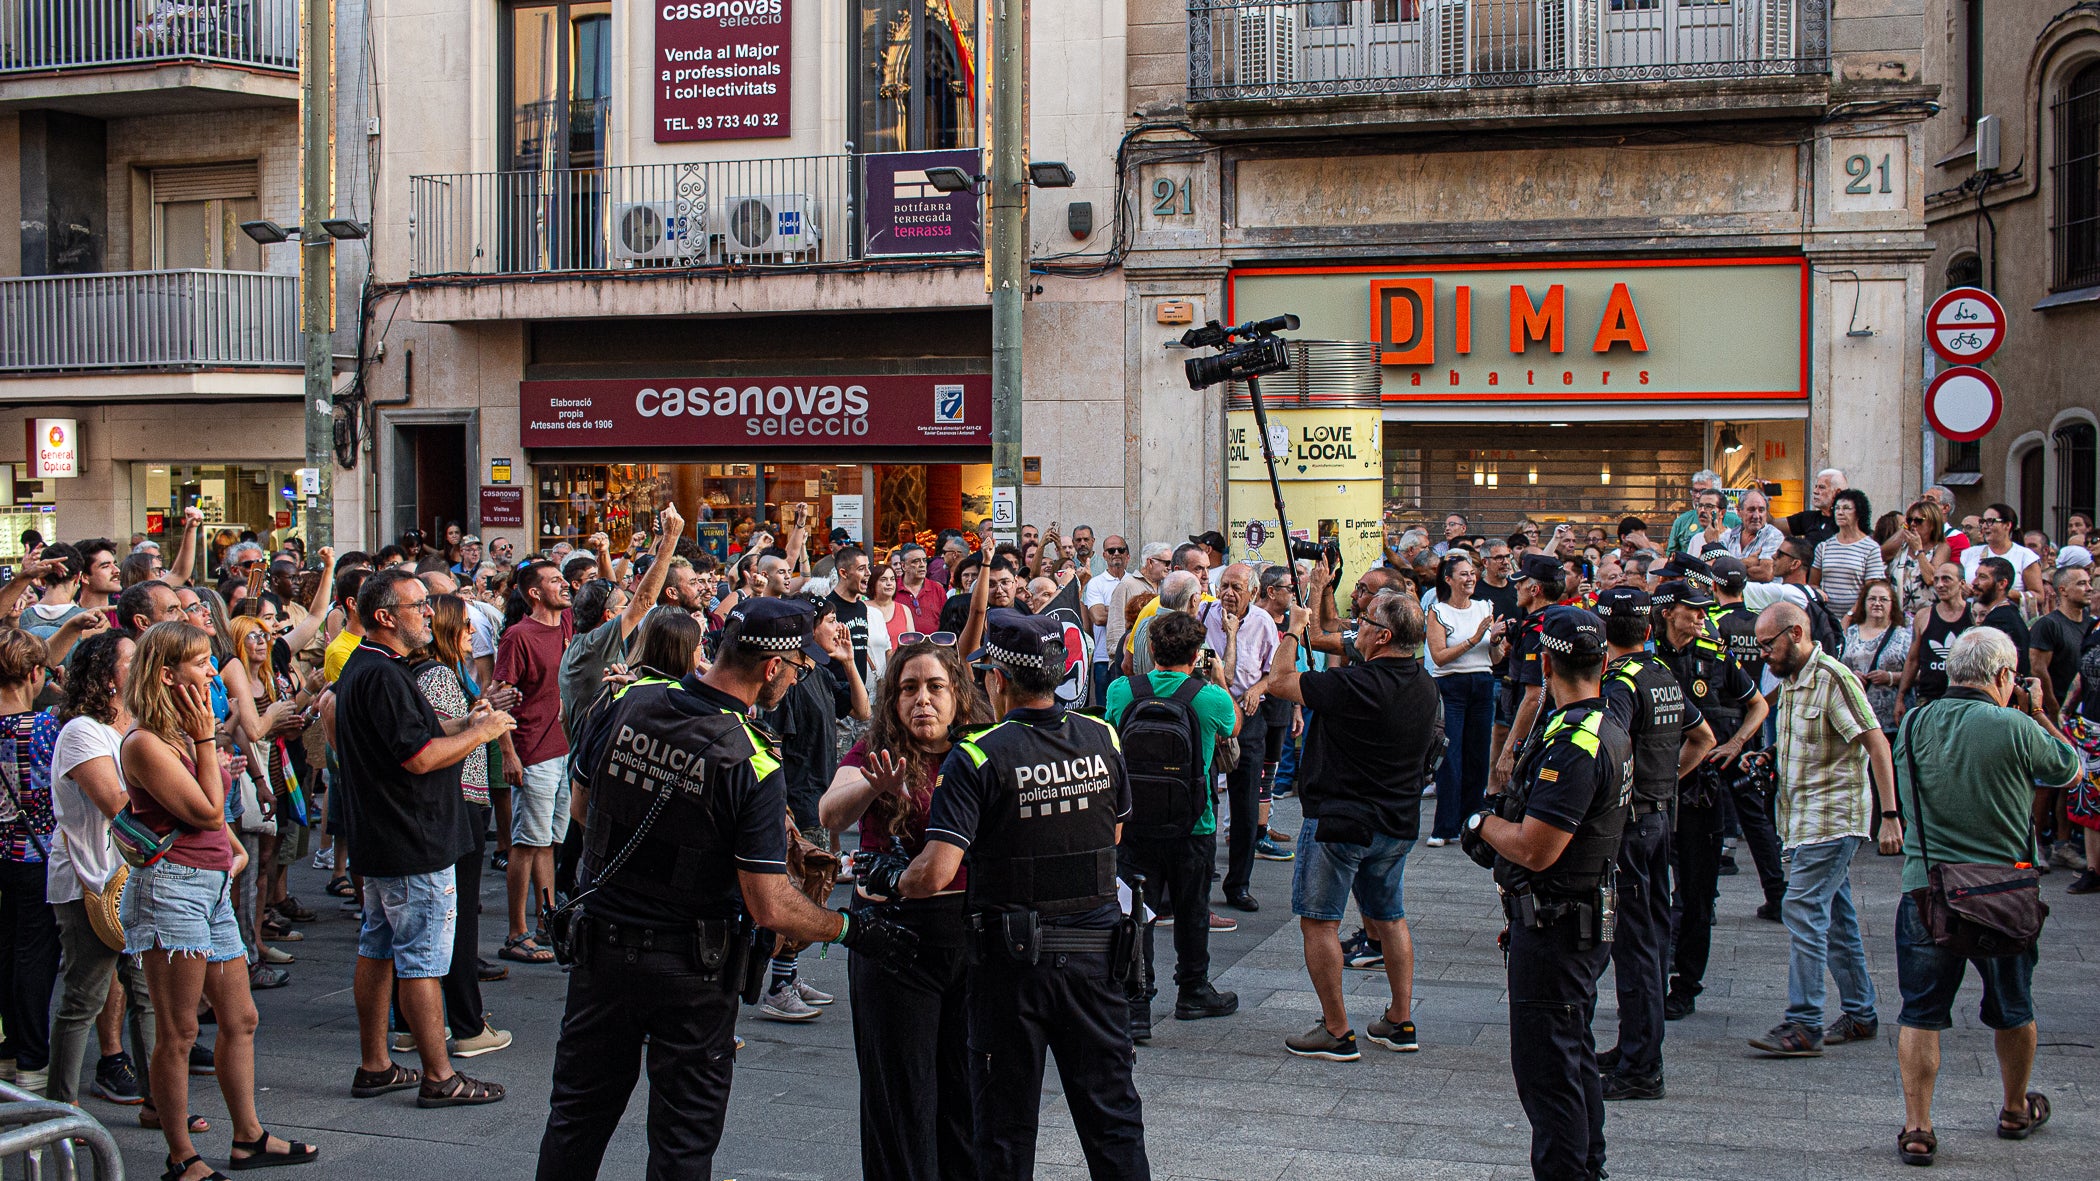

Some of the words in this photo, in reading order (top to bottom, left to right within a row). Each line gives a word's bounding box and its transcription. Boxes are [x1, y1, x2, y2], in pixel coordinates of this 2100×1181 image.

[663, 0, 782, 20] casanovas
[720, 11, 782, 28] selecció
[664, 46, 713, 62] Venda
[717, 45, 731, 59] al
[735, 43, 780, 60] Major
[662, 70, 671, 81] a
[675, 61, 781, 83] professionals
[665, 86, 670, 100] i
[674, 81, 777, 99] col·lectivitats
[664, 117, 694, 131] TEL.
[697, 116, 713, 129] 93
[716, 115, 740, 128] 733
[743, 114, 759, 127] 40
[762, 113, 779, 126] 32
[1846, 153, 1892, 194] 21
[1153, 175, 1193, 216] 21
[1371, 279, 1649, 358] DIMA
[550, 398, 592, 408] Elaboració
[636, 385, 869, 418] casanovas
[558, 410, 584, 420] propia
[746, 412, 869, 436] selecció
[530, 421, 565, 430] Artesans
[567, 421, 580, 429] des
[583, 420, 593, 429] de
[595, 420, 613, 429] 1906
[1303, 426, 1352, 442] LOVE
[41, 449, 74, 460] General
[1297, 444, 1356, 460] LOCAL
[1345, 519, 1353, 528] El
[1356, 519, 1376, 530] primer
[1360, 530, 1368, 538] de
[1041, 632, 1061, 643] POLICIA
[1577, 625, 1597, 634] POLICIA
[1650, 686, 1684, 704] POLICIA
[611, 748, 647, 773] policia
[616, 724, 706, 782] POLICIA
[1015, 753, 1109, 789] POLICIA
[1019, 785, 1058, 806] policia
[1061, 775, 1111, 797] municipal
